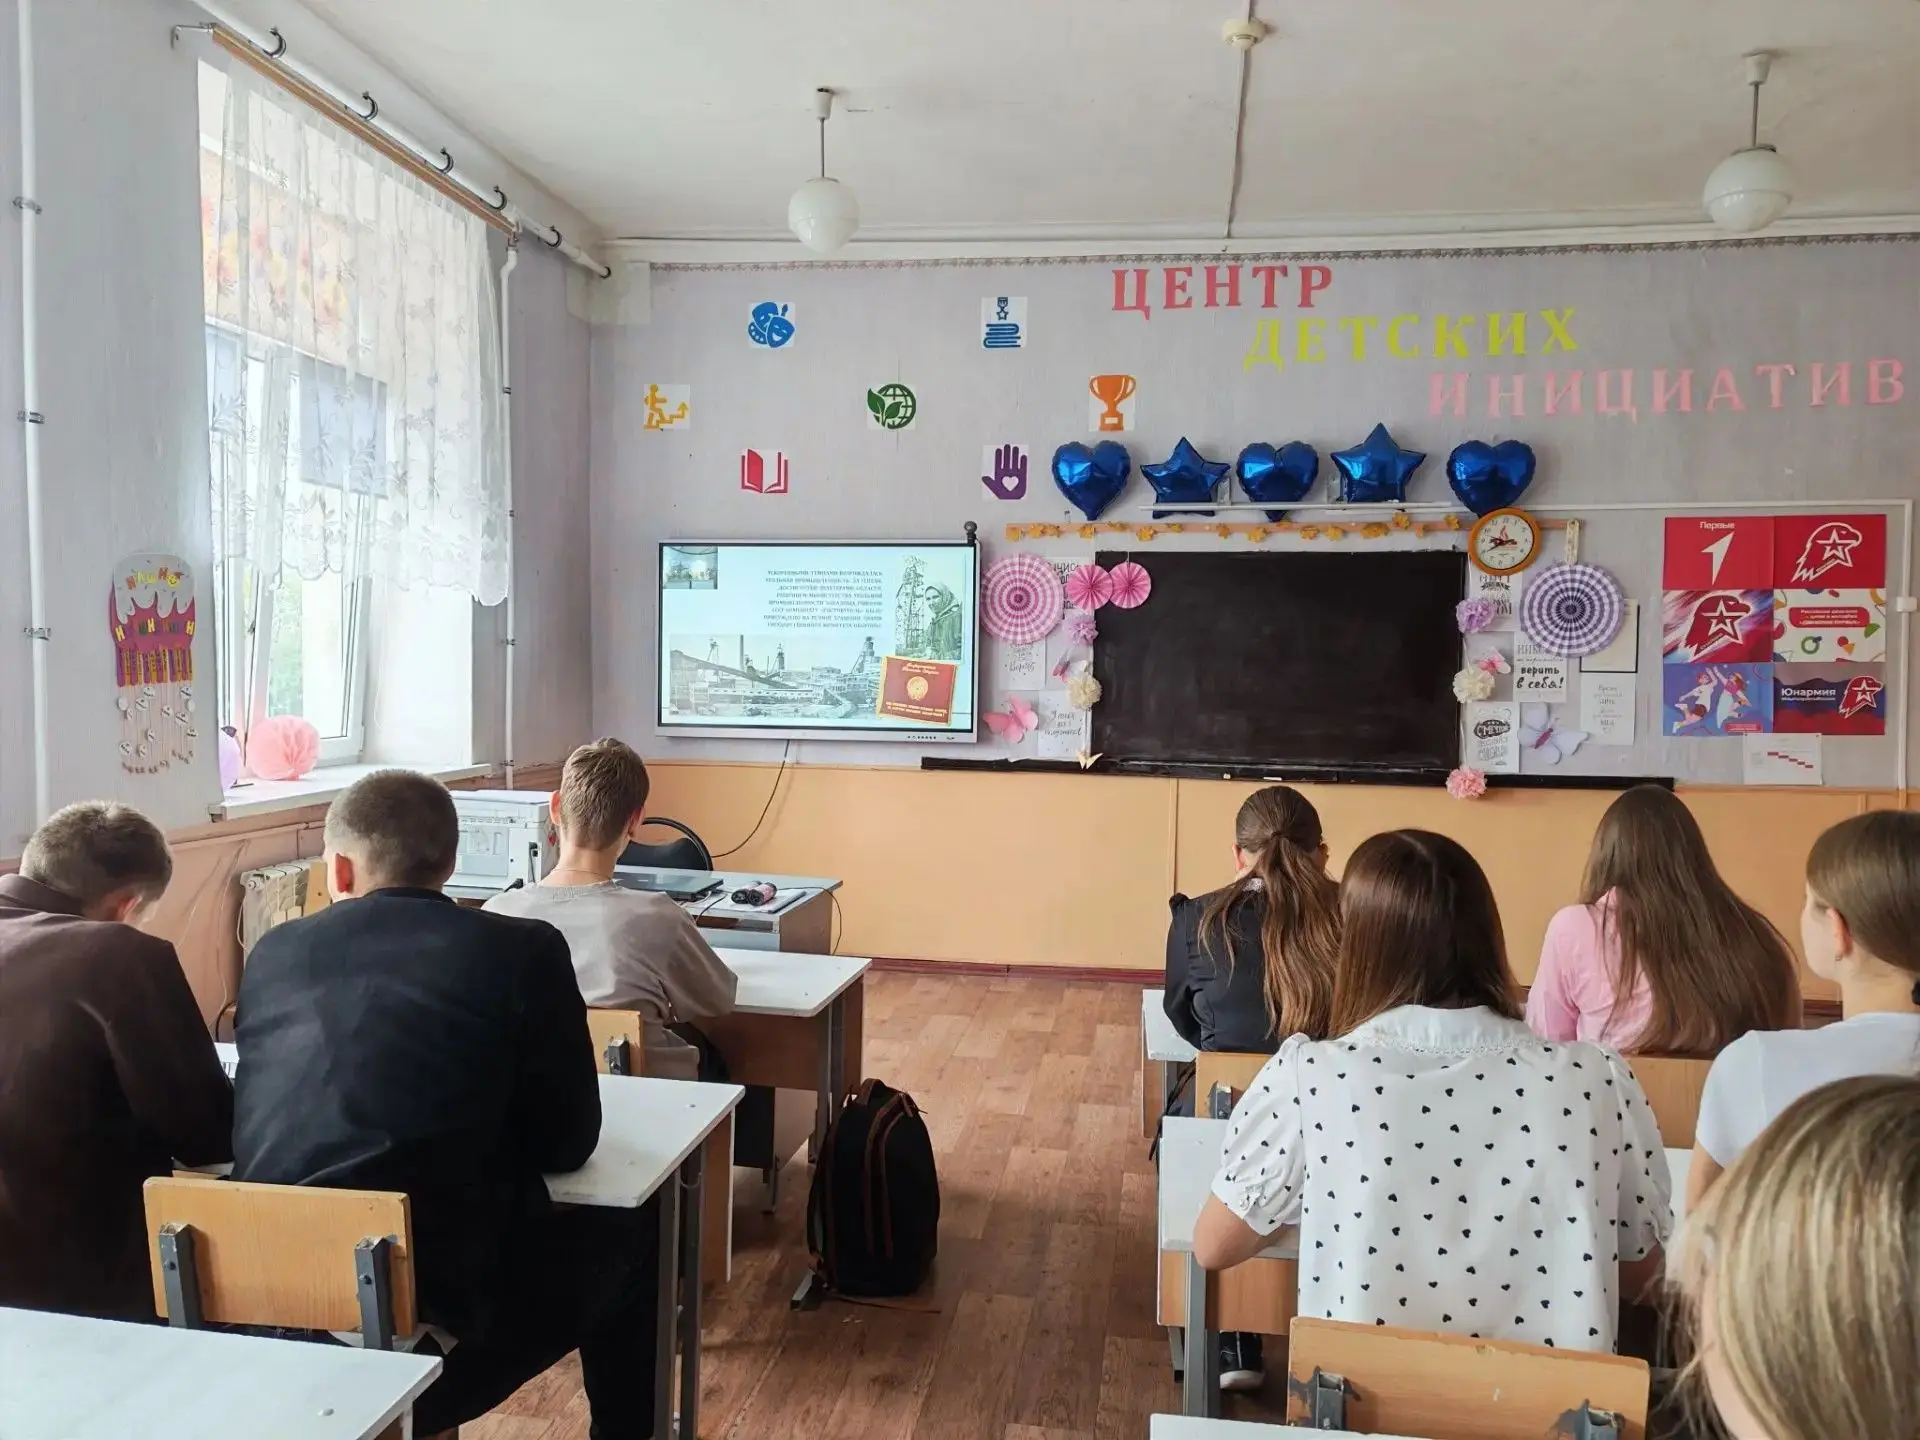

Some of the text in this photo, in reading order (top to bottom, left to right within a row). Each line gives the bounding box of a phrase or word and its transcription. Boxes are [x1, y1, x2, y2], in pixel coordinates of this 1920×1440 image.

[1111, 264, 1333, 320] ЦЕНТР
[1243, 307, 1579, 373] ДЕТСКИХ
[1428, 358, 1905, 424] ИНИЦИАТИВ
[1700, 521, 1735, 531] Первые
[1521, 666, 1560, 677] верить
[1517, 676, 1564, 689] в себя!
[1781, 688, 1836, 697] Юнармия
